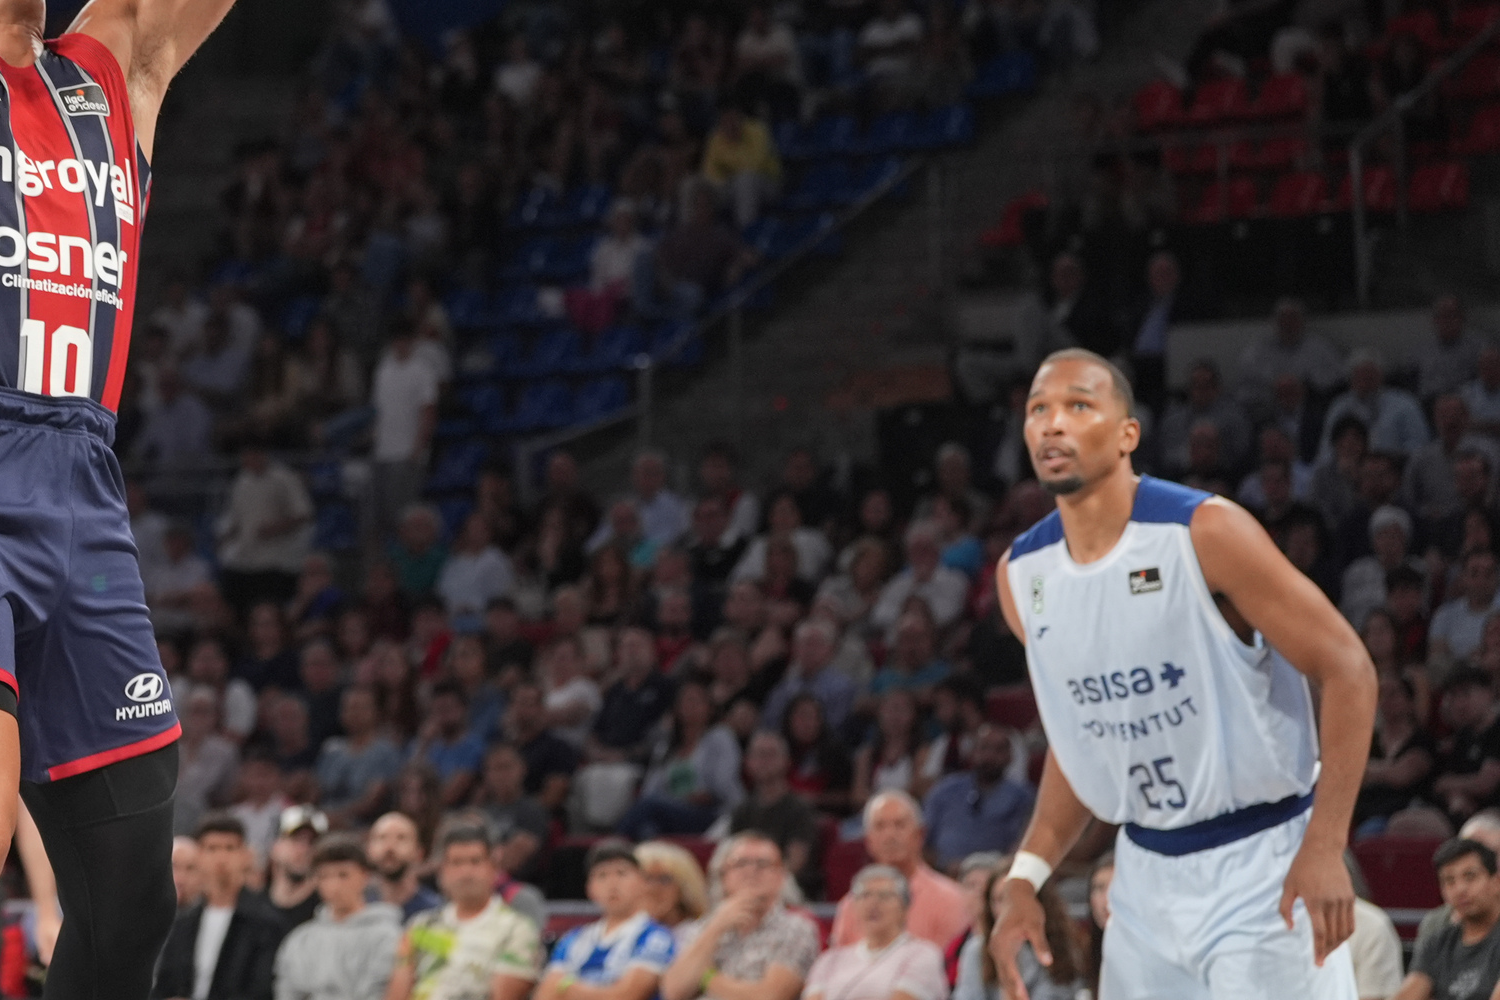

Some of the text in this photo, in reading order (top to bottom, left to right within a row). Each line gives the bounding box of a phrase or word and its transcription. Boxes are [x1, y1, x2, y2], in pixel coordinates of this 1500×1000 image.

[63, 94, 85, 106] liga
[68, 101, 107, 112] endesa
[1, 272, 93, 300] Climatización
[20, 318, 92, 398] 10
[1067, 667, 1155, 706] asisa
[116, 699, 171, 721] HYUNDAI
[1128, 755, 1188, 811] 25
